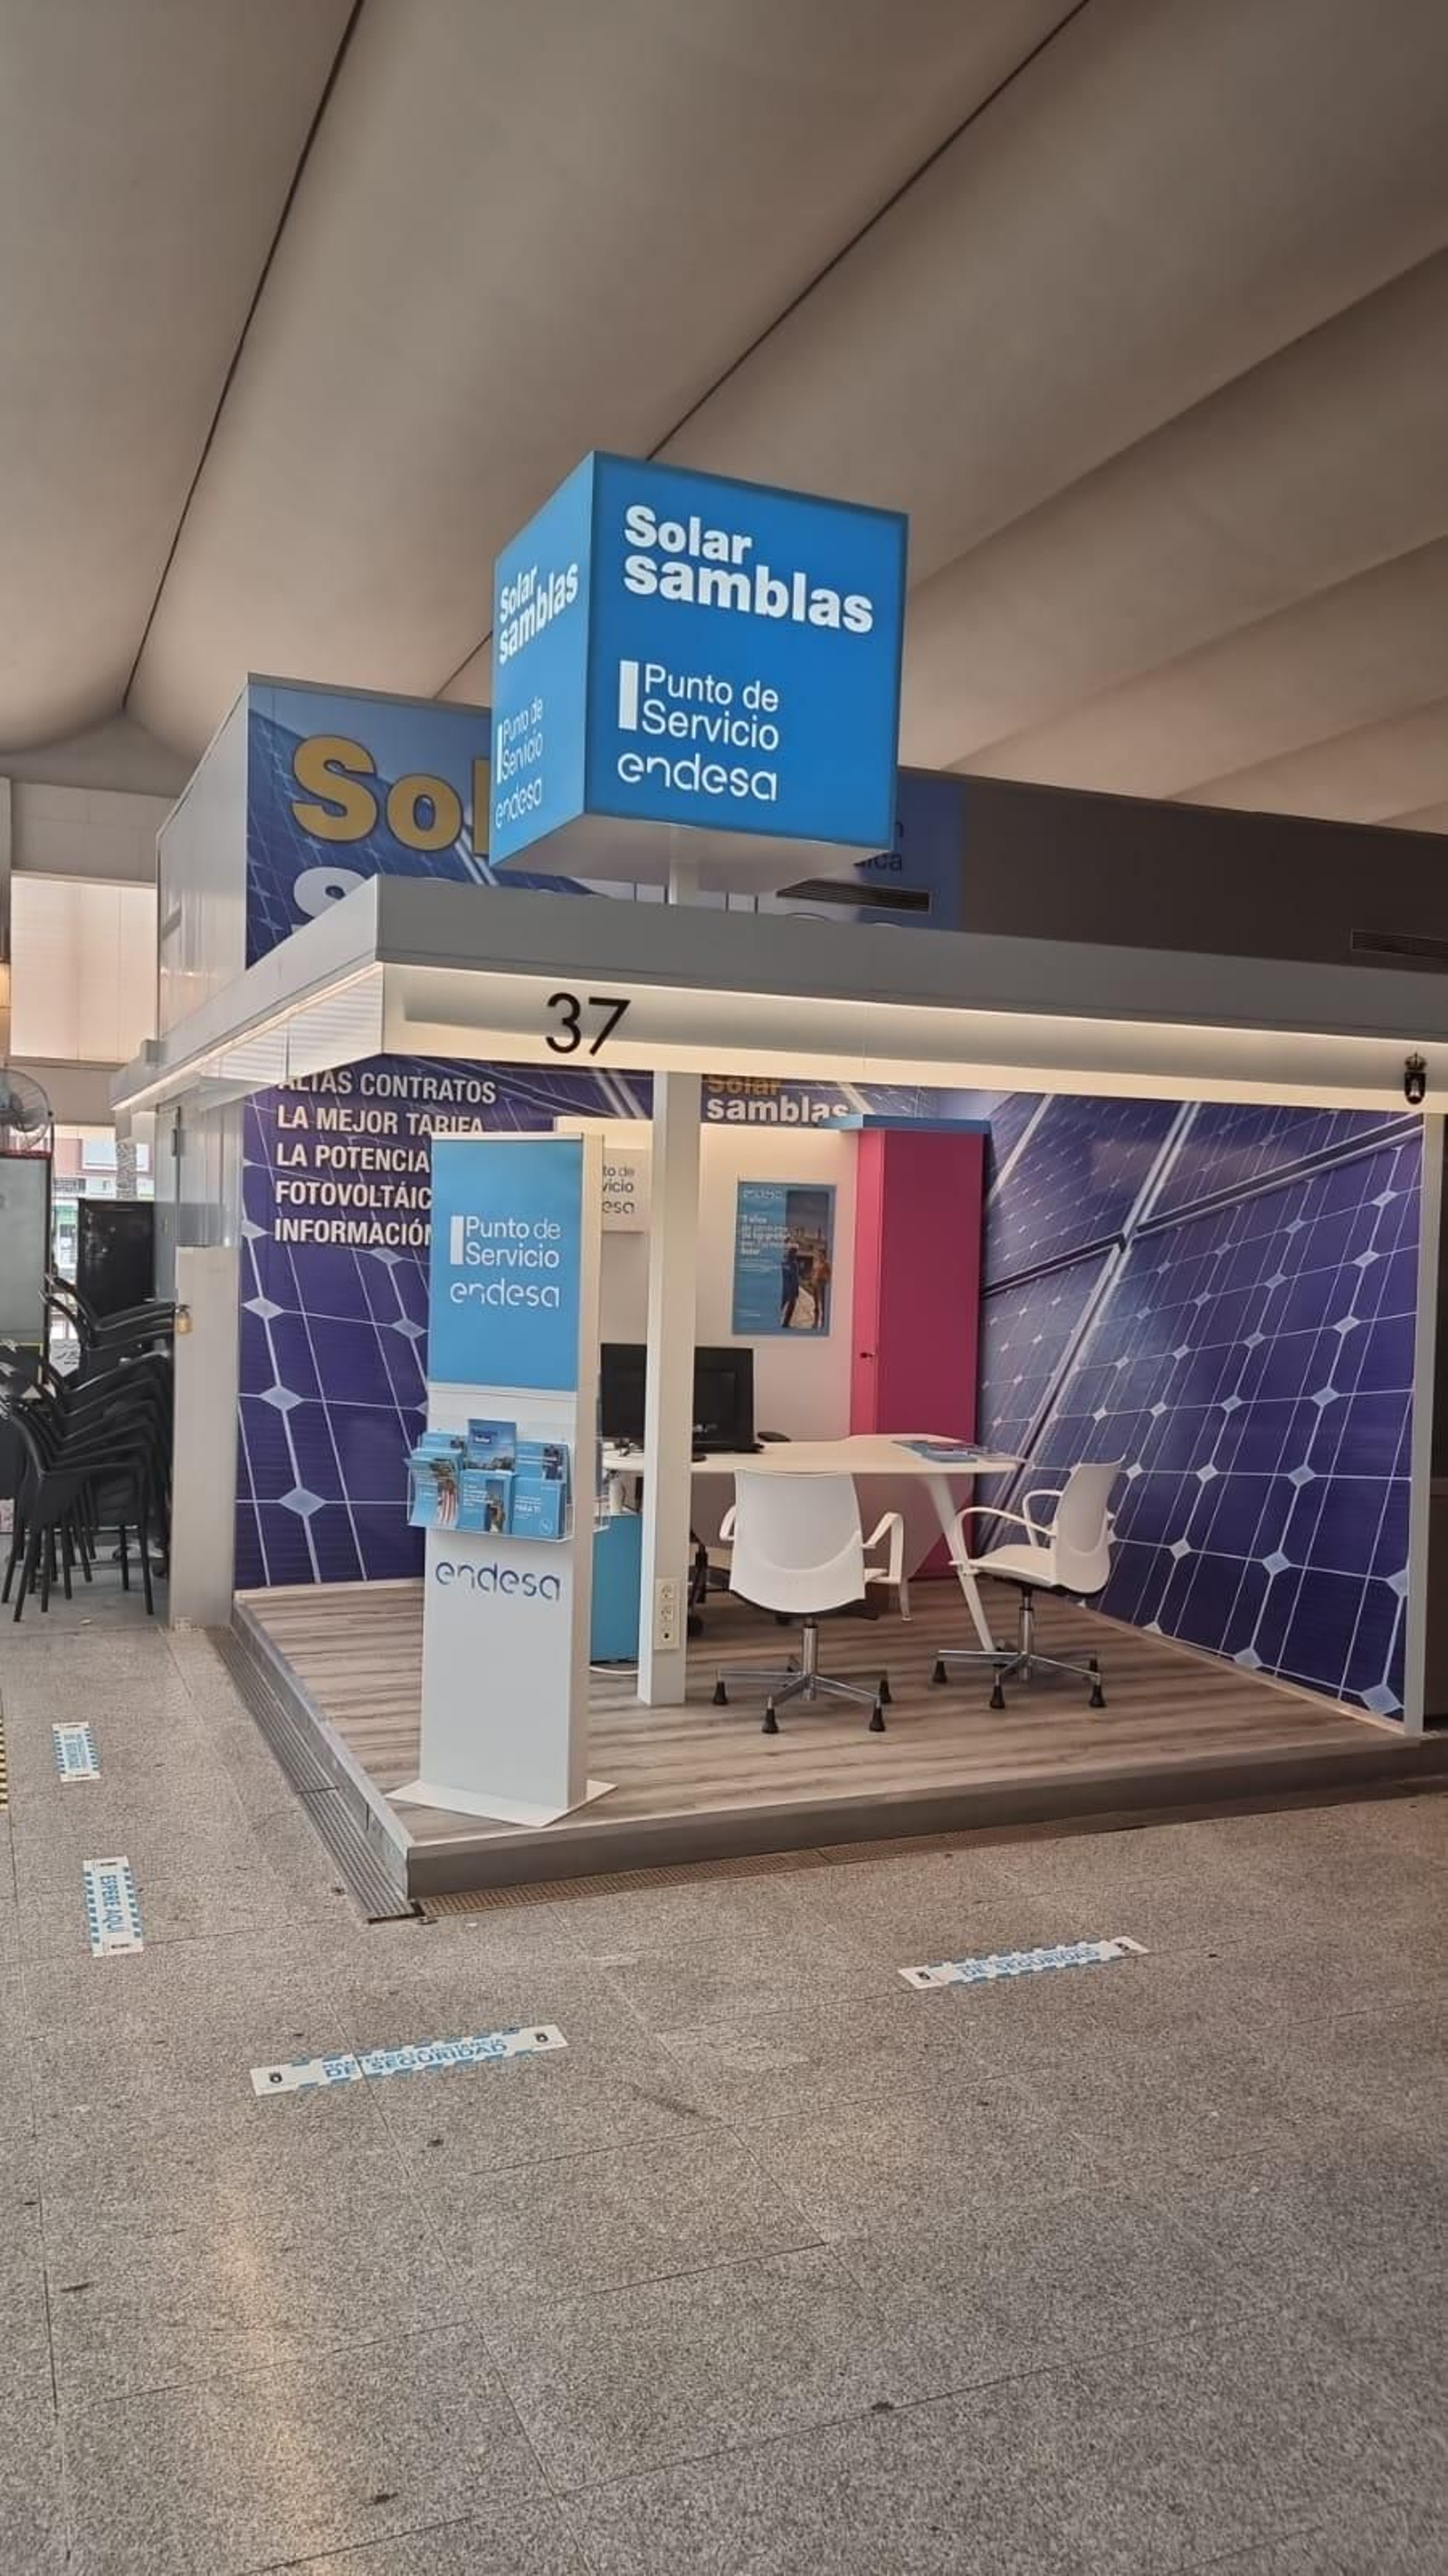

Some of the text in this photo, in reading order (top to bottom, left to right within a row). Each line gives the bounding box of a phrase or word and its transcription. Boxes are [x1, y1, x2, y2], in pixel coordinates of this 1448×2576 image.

[624, 505, 753, 565] Solar
[500, 565, 538, 624] Solar
[624, 554, 874, 634] samblas
[500, 563, 578, 665] samblas
[644, 663, 779, 712] Punto de
[642, 699, 779, 750] Servicio
[617, 752, 777, 801] endesa
[291, 734, 490, 858] Sol
[545, 992, 632, 1057] 37
[360, 1073, 497, 1104] CONTRATOS
[278, 1104, 484, 1136] LA MEJOR TARIFA
[277, 1143, 431, 1173] LA POTENCIA
[275, 1179, 433, 1210] FOTOVOLTÁIC
[603, 1178, 634, 1193] vicio
[602, 1200, 635, 1214] esa
[466, 1216, 561, 1239] Punto de
[465, 1241, 560, 1268] Servicio
[450, 1277, 560, 1308] endesa
[435, 1561, 561, 1602] endesa
[371, 2039, 508, 2072] SEGURIDAD
